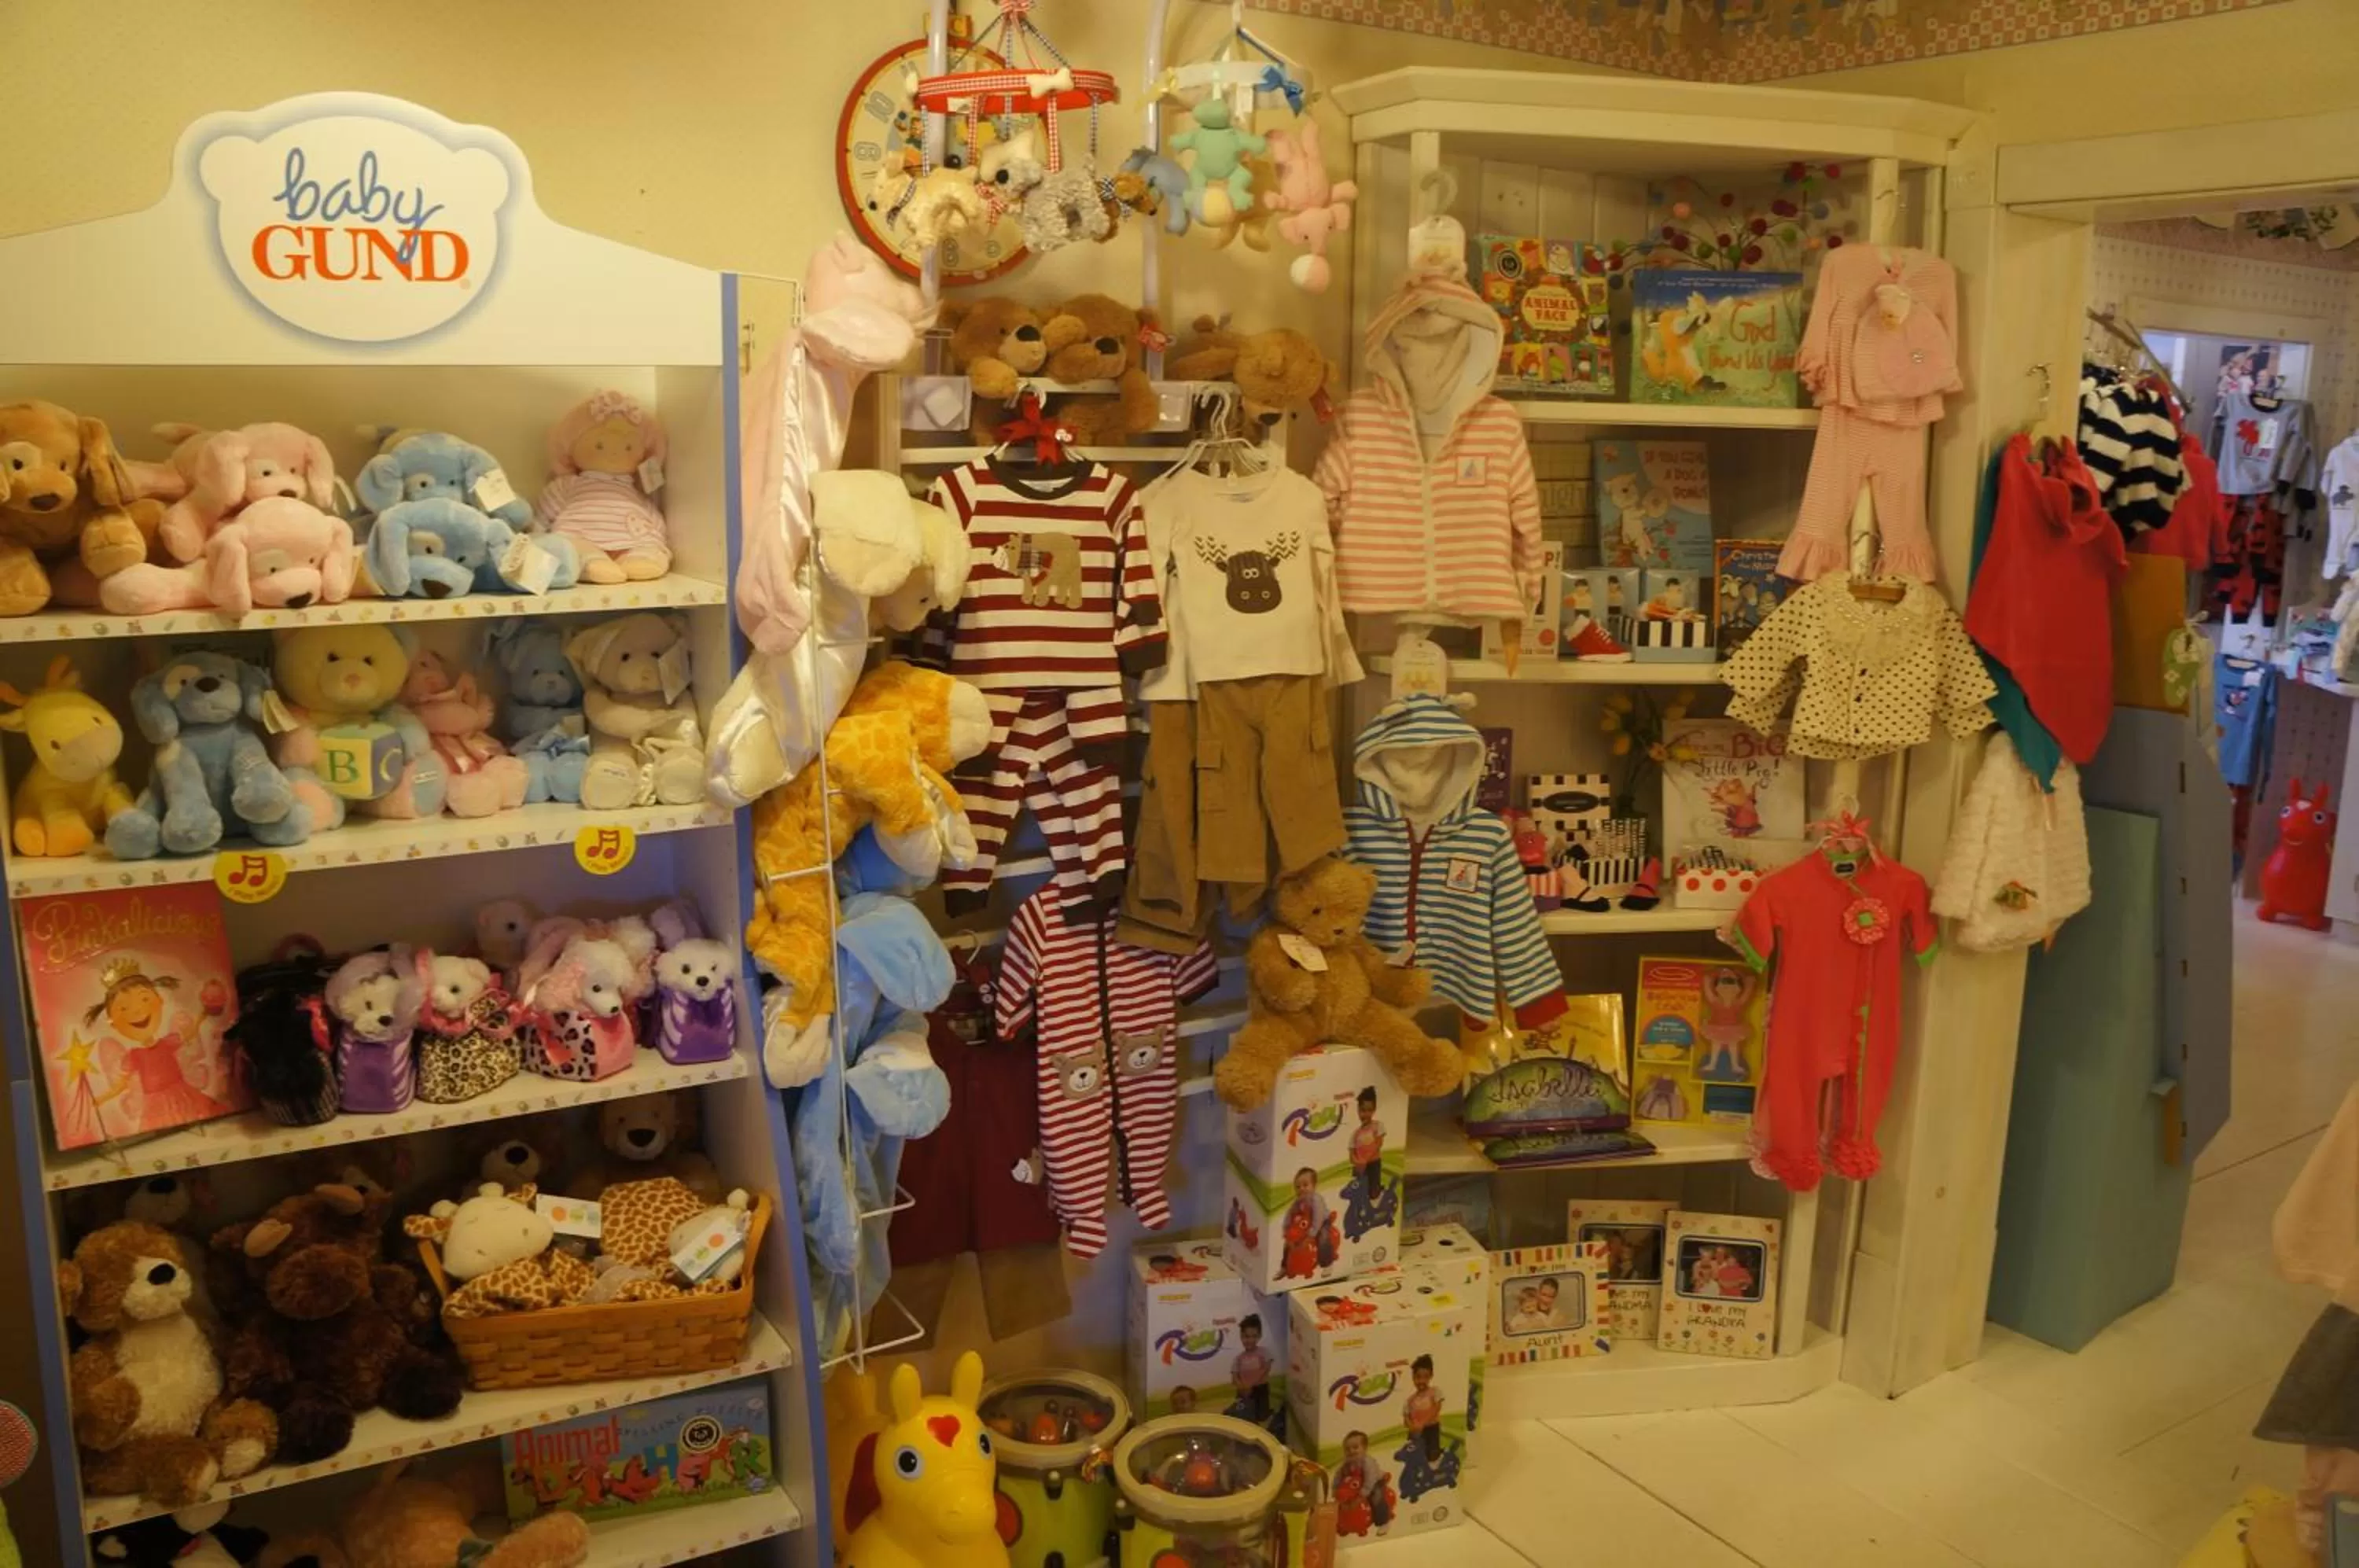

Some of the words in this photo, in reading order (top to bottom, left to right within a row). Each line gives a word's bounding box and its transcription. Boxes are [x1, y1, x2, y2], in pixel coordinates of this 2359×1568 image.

[273, 147, 445, 263] baby
[252, 225, 469, 282] GUND
[324, 749, 360, 783] B
[514, 1415, 620, 1474] Animal
